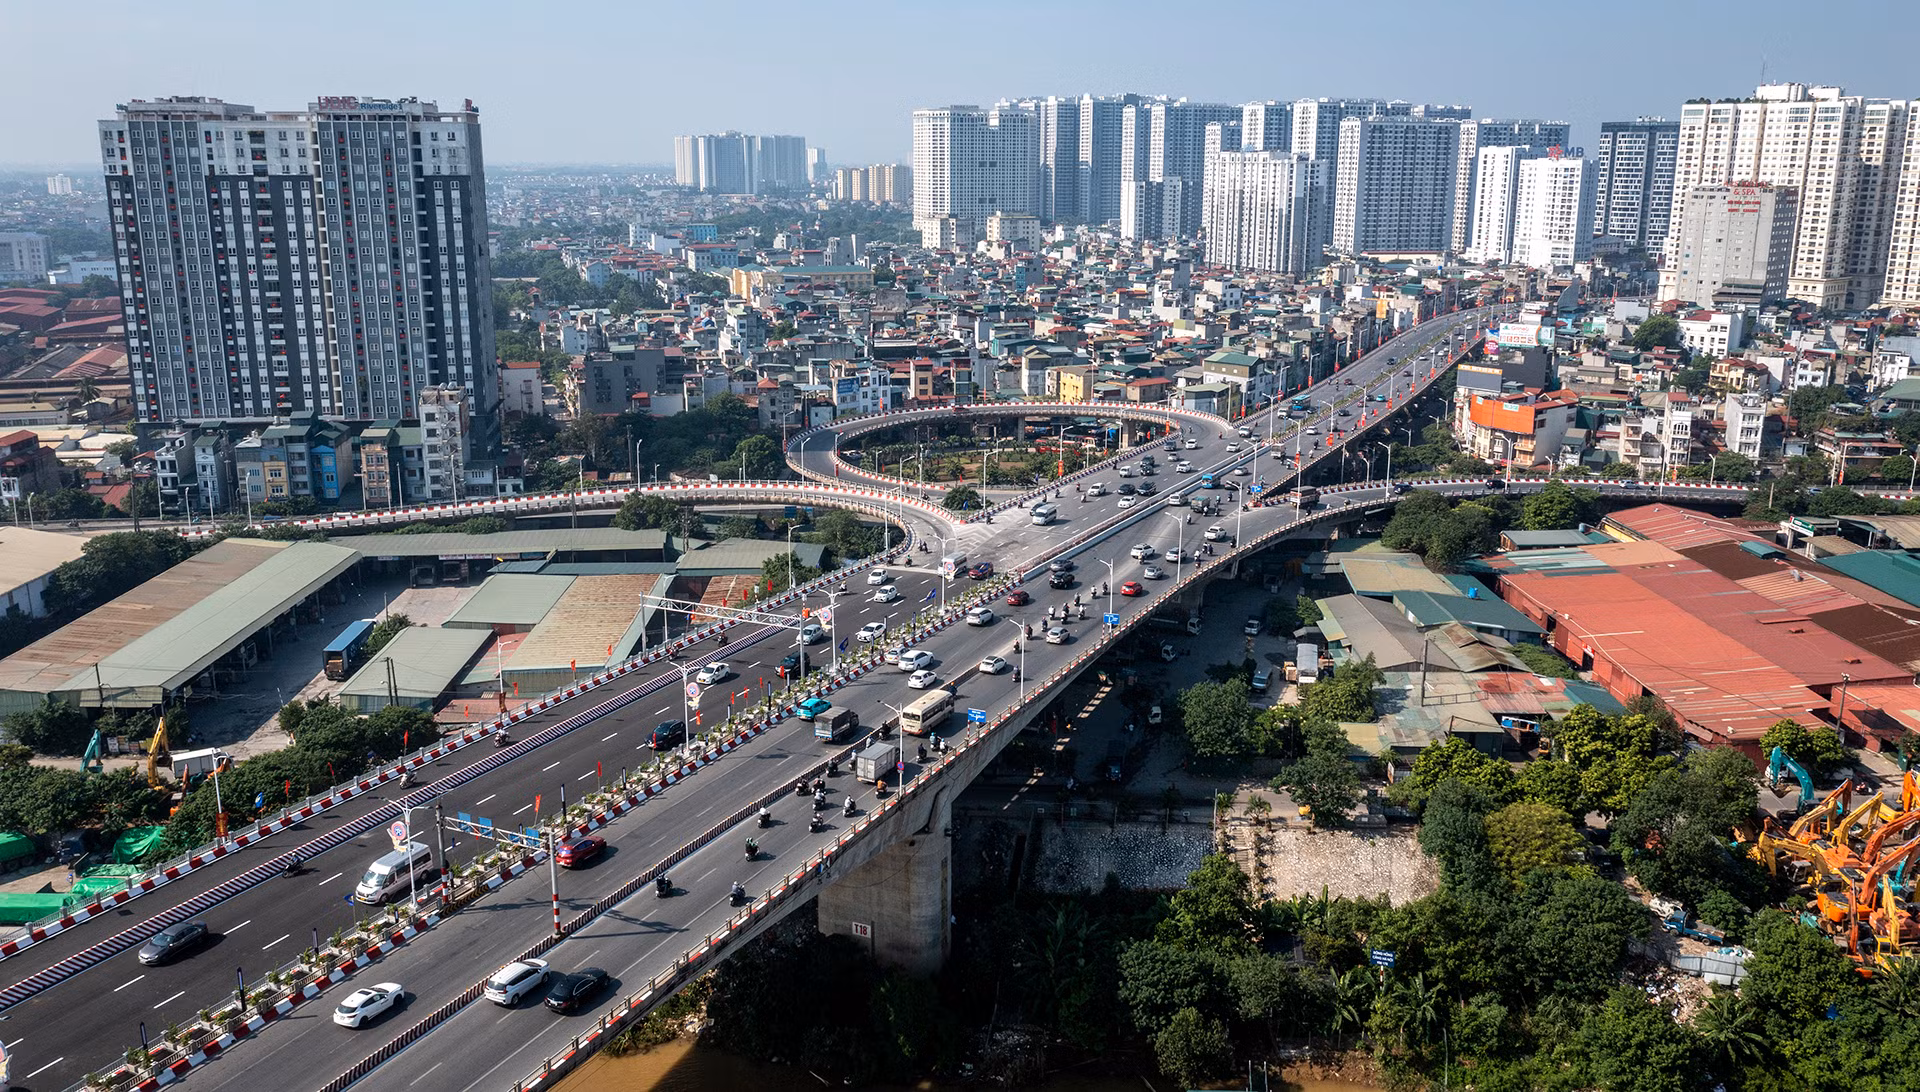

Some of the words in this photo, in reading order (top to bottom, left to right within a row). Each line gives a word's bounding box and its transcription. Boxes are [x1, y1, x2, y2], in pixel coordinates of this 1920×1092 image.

[360, 103, 398, 111] Riverside
[1564, 146, 1585, 158] MB
[854, 924, 868, 936] T18
